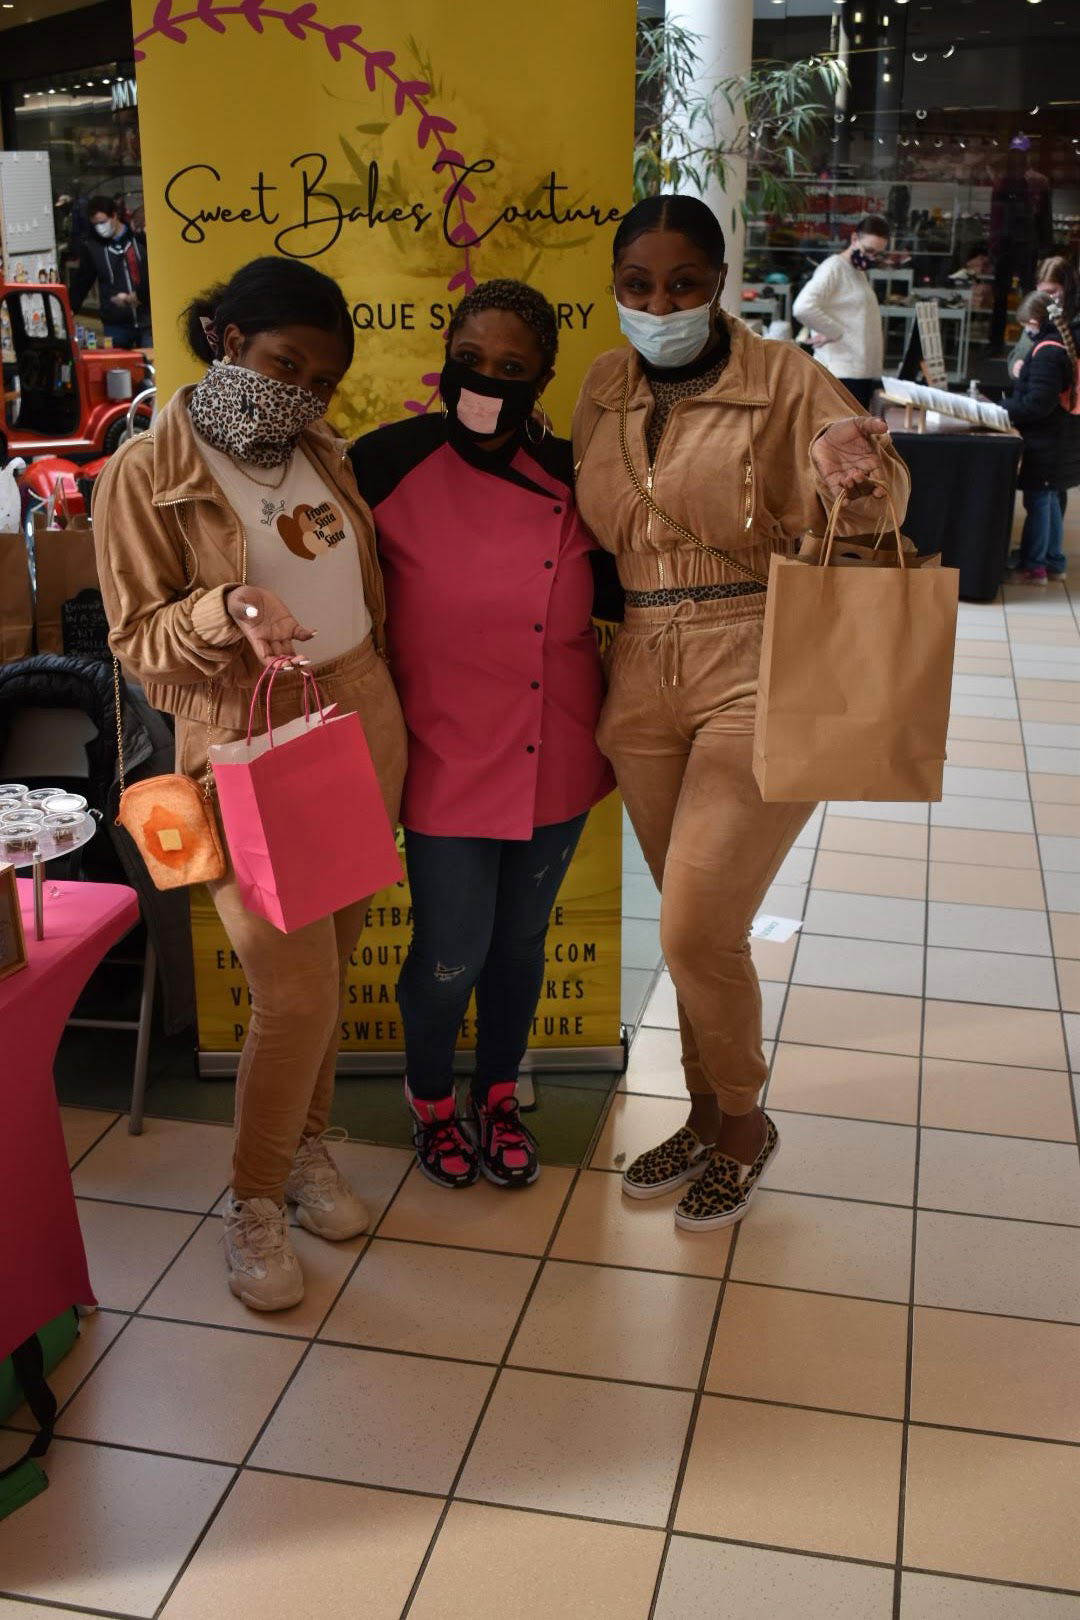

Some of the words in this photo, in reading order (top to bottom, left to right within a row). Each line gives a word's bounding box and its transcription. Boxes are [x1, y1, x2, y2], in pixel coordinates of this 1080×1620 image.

[164, 164, 279, 244] Sweet
[274, 153, 432, 259] Bakes
[432, 159, 628, 248] Couture
[304, 502, 331, 521] From
[315, 513, 337, 529] Sista
[313, 530, 325, 540] To
[325, 530, 346, 547] Sista
[349, 945, 413, 966] COUT
[545, 943, 596, 963] .COM
[539, 980, 584, 999] KES
